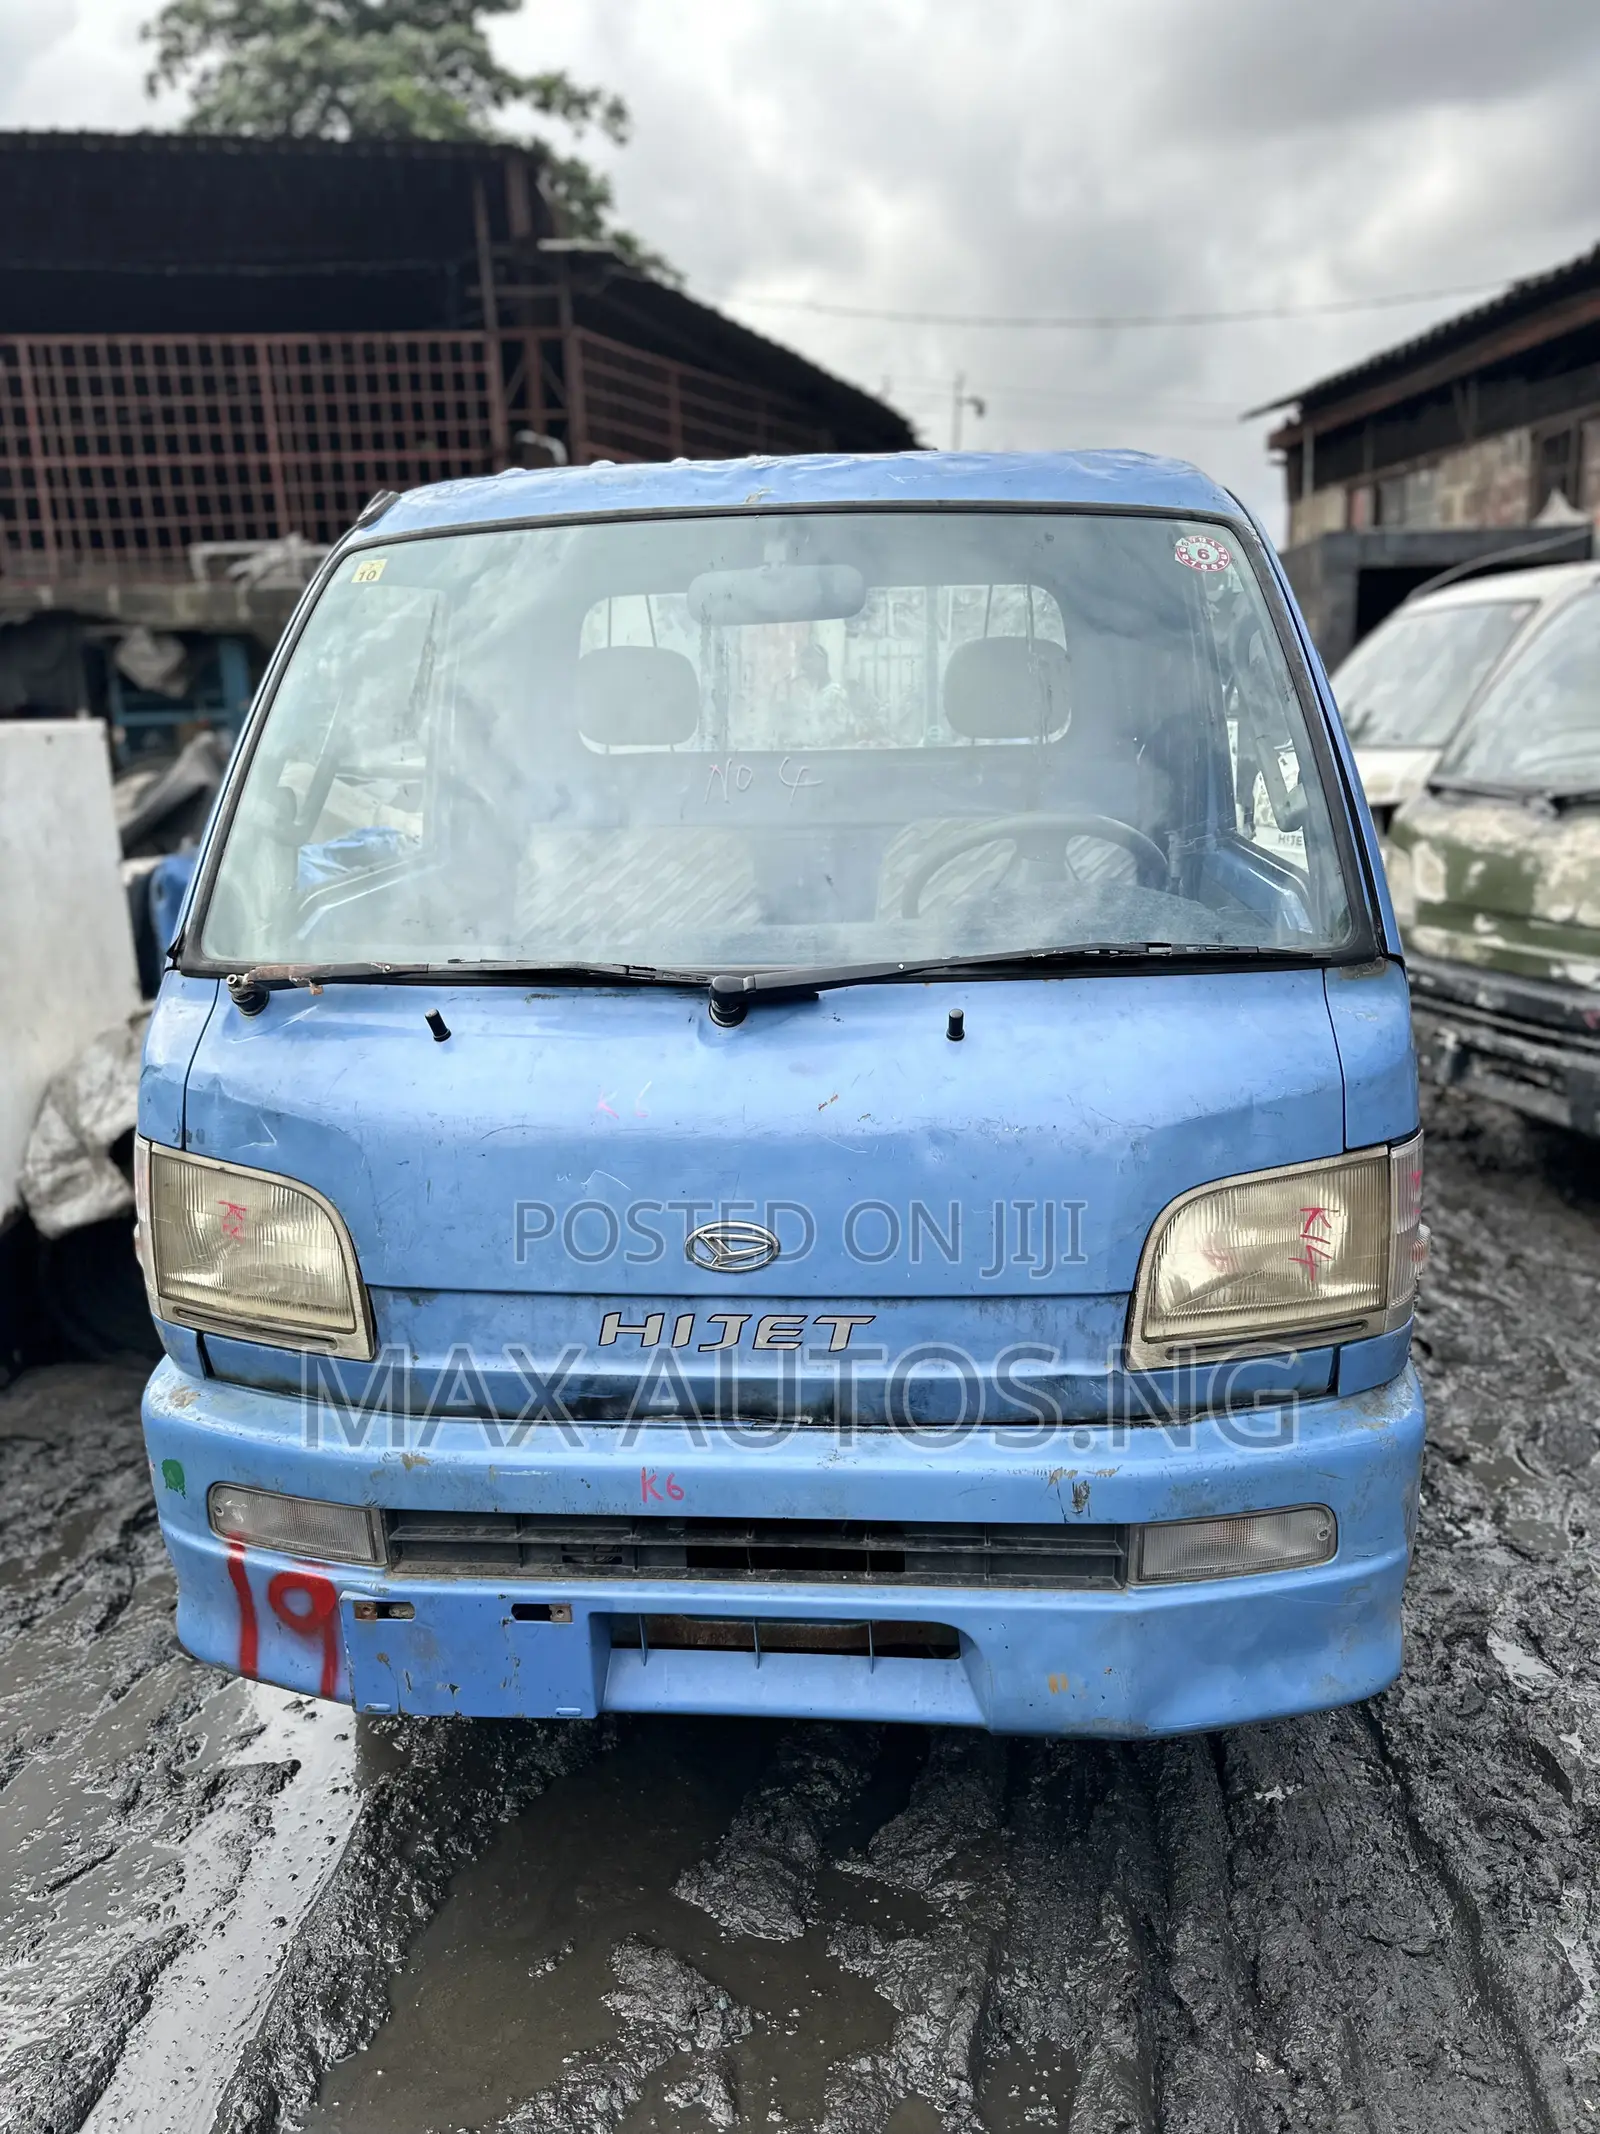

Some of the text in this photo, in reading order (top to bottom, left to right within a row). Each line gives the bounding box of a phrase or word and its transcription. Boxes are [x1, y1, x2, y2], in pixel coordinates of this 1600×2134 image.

[1197, 548, 1210, 560] 6
[358, 570, 377, 581] 10
[598, 1312, 877, 1353] HIJET
[641, 1466, 685, 1503] K6
